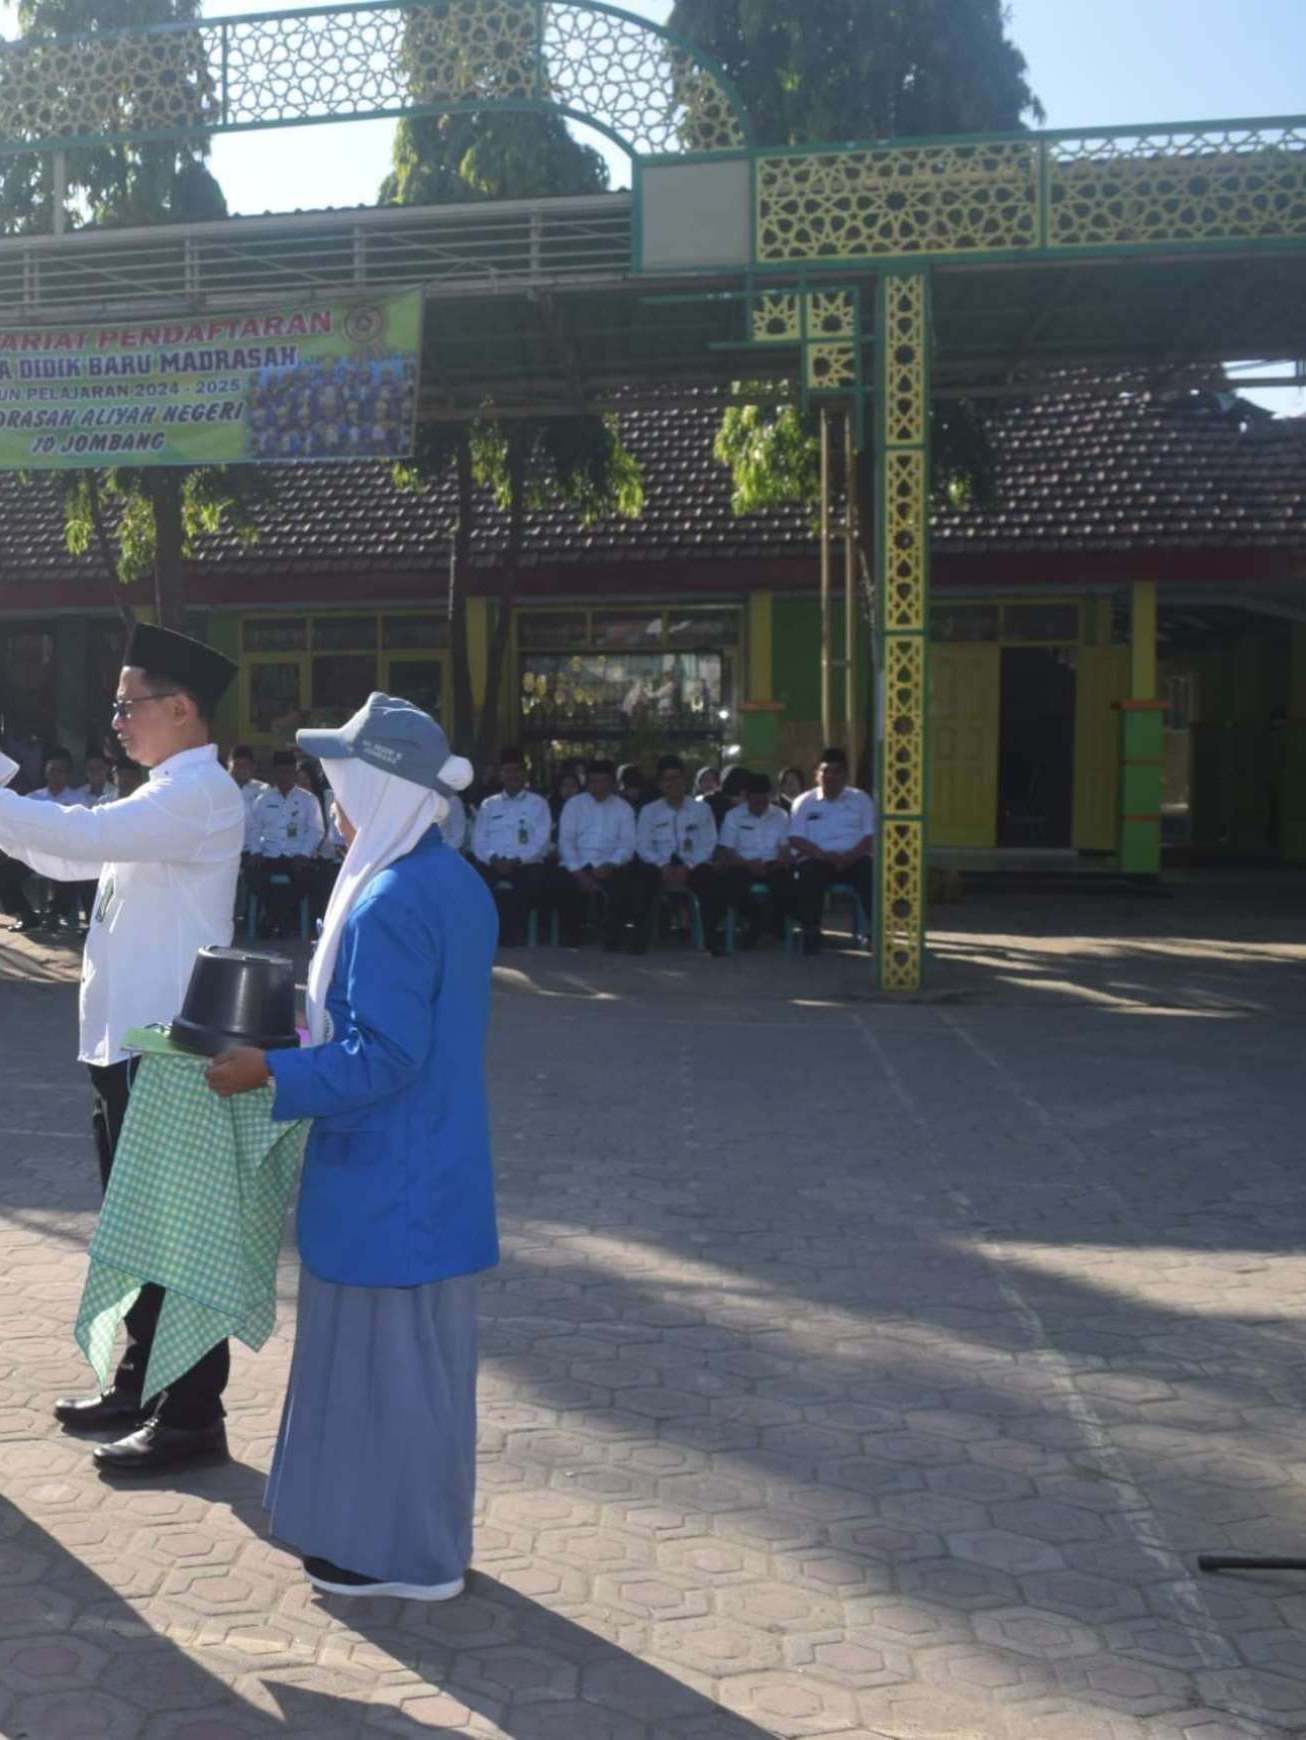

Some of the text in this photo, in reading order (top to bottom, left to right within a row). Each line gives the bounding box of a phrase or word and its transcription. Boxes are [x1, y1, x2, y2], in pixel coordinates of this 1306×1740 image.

[98, 311, 332, 348] PENDAFTARAN
[19, 358, 81, 379] DIDIK
[89, 354, 151, 376] BARU
[160, 345, 298, 373] MADRASAH
[26, 384, 128, 400] PELAJARAN
[135, 382, 180, 397] 2024
[195, 378, 241, 394] 2025
[81, 406, 157, 426] ALIYAH
[162, 402, 243, 422] NEGERI
[32, 432, 166, 453] 10 JOMBANG
